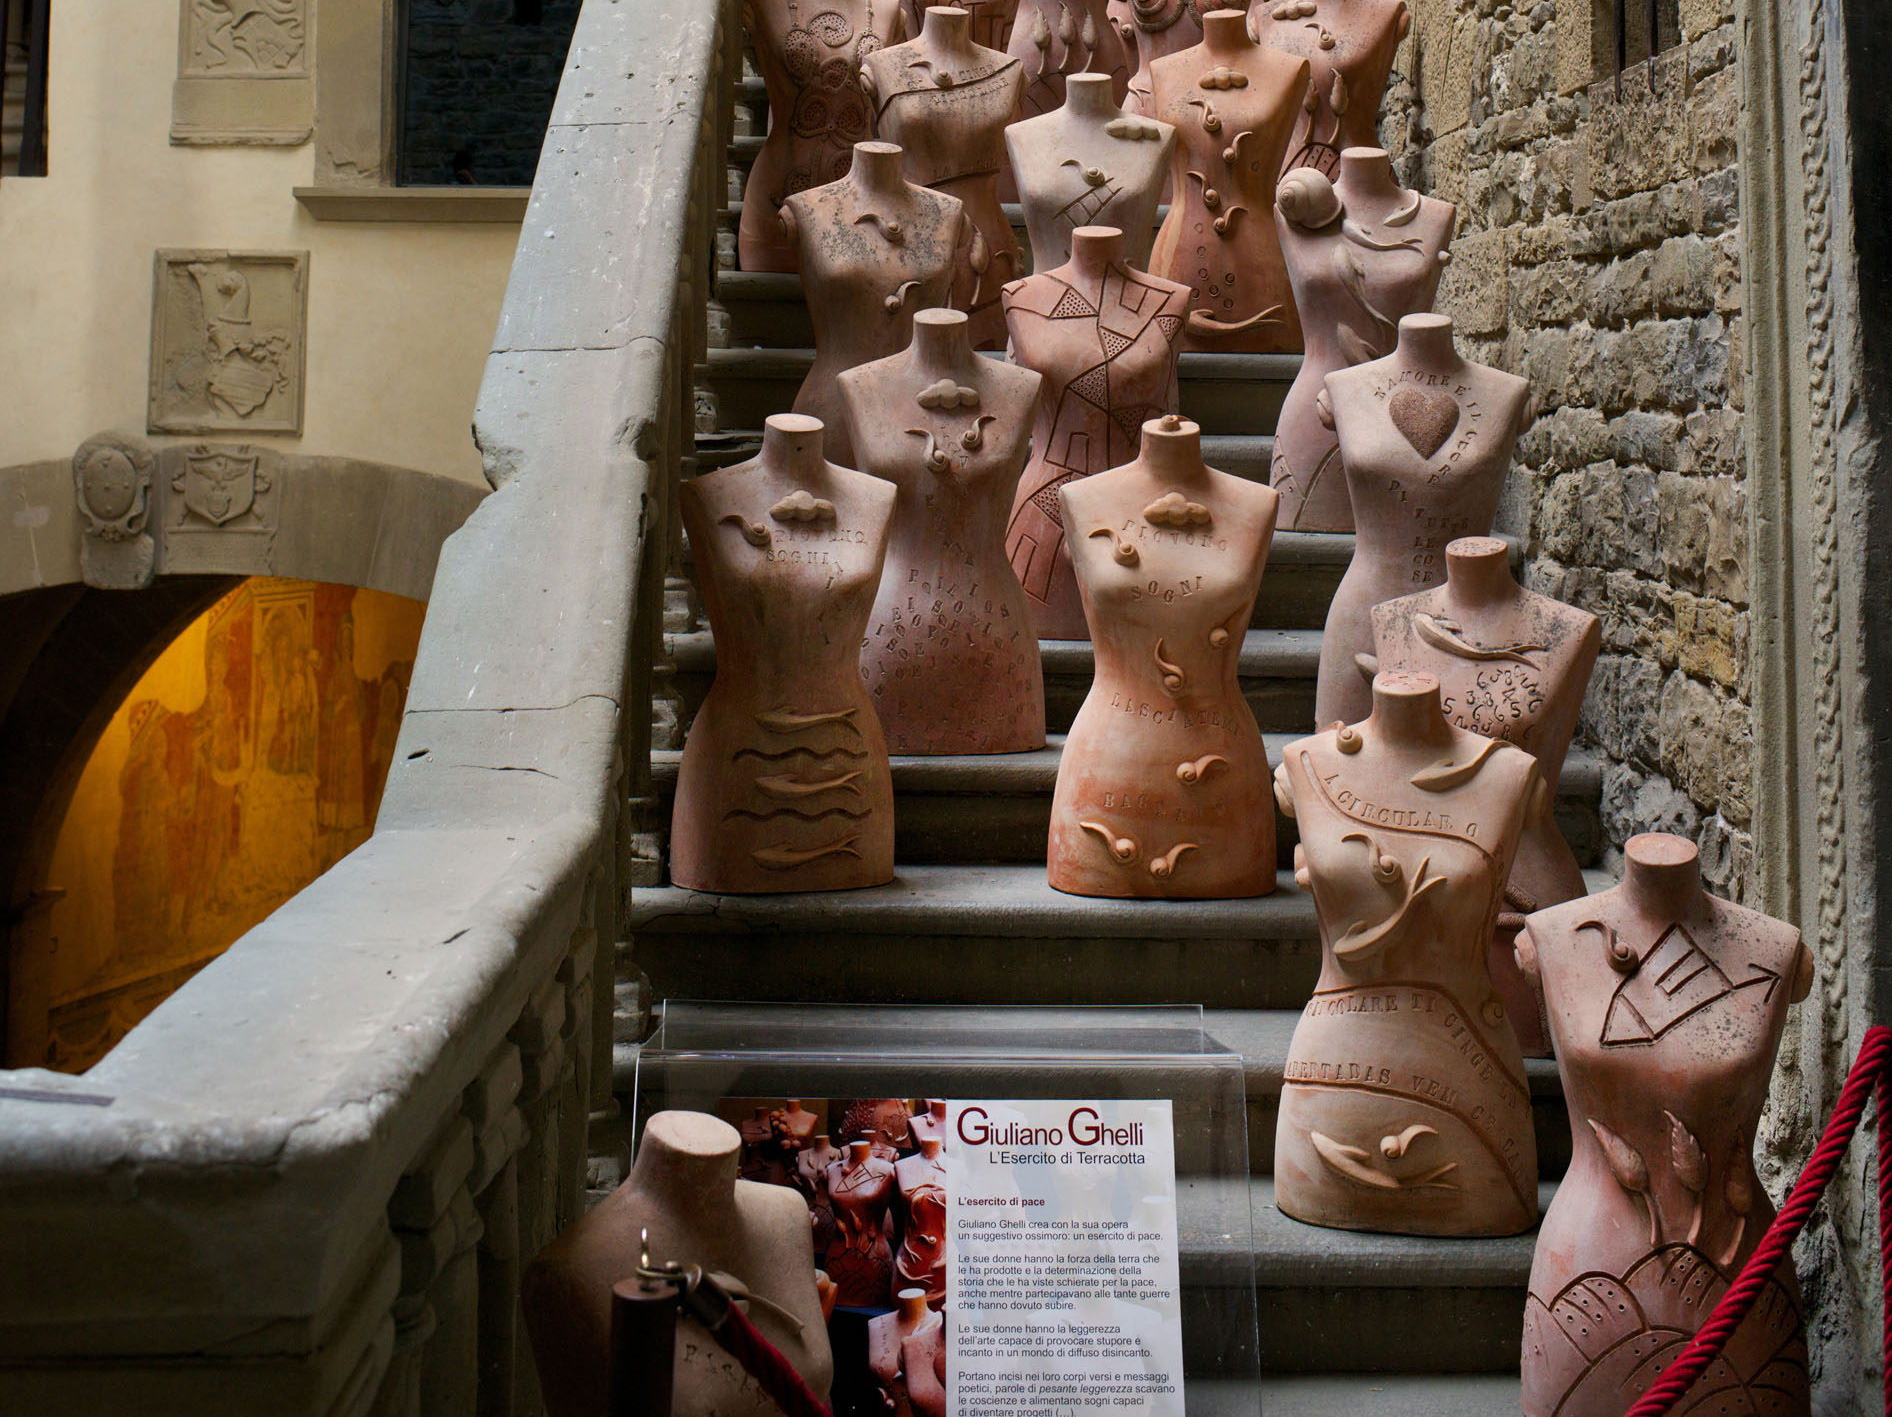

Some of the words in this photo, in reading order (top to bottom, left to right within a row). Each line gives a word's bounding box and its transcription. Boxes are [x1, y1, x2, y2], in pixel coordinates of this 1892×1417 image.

[1130, 575, 1204, 605] SOGNI
[957, 1107, 1063, 1146] Giuliano
[1068, 1107, 1144, 1146] Ghelli
[989, 1151, 1056, 1164] L'Esercito
[1060, 1151, 1072, 1164] di
[1076, 1151, 1145, 1164] Terracotta
[958, 1196, 1007, 1205] L'esercito
[1009, 1196, 1018, 1205] di
[1021, 1199, 1045, 1208] pace
[958, 1219, 996, 1228] Giuliano
[999, 1219, 1026, 1228] Ghelli
[1071, 1219, 1080, 1228] la
[1102, 1222, 1129, 1232] opera
[972, 1230, 1023, 1243] suggestivo
[1025, 1230, 1070, 1240] ossimoro:
[1088, 1230, 1124, 1240] esercito
[1126, 1230, 1135, 1240] di
[1138, 1233, 1163, 1243] pace.
[958, 1253, 970, 1263] Le
[992, 1253, 1022, 1263] donne
[1024, 1253, 1054, 1263] hanno
[1056, 1253, 1064, 1263] la
[1067, 1253, 1091, 1263] forza
[1093, 1253, 1116, 1263] della
[1118, 1254, 1140, 1263] terra
[1142, 1253, 1160, 1263] che
[958, 1264, 967, 1274] le
[969, 1264, 981, 1274] ha
[984, 1264, 1022, 1278] prodotte
[1034, 1264, 1042, 1274] la
[1044, 1264, 1117, 1274] determinazione
[1119, 1264, 1142, 1274] della
[958, 1276, 984, 1286] storia
[986, 1276, 1004, 1286] che
[1006, 1276, 1015, 1286] le
[1018, 1276, 1030, 1286] ha
[1032, 1276, 1054, 1286] viste
[1056, 1276, 1100, 1286] schierate
[1102, 1279, 1117, 1289] per
[1120, 1276, 1128, 1286] la
[1131, 1279, 1157, 1289] pace,
[958, 1288, 988, 1298] anche
[990, 1289, 1023, 1298] mentre
[1025, 1288, 1092, 1301] partecipavano
[1094, 1288, 1111, 1298] alle
[1113, 1289, 1137, 1298] tante
[1139, 1291, 1170, 1301] guerre
[958, 1299, 976, 1310] che
[978, 1299, 1008, 1310] hanno
[1010, 1299, 1042, 1310] dovuto
[1044, 1299, 1076, 1310] subire.
[958, 1323, 970, 1333] Le
[992, 1323, 1022, 1333] donne
[1025, 1323, 1055, 1333] hanno
[1058, 1323, 1066, 1333] la
[1068, 1323, 1121, 1336] leggerezza
[958, 1334, 996, 1345] dell'arte
[998, 1338, 1033, 1348] capace
[1035, 1334, 1044, 1345] di
[1046, 1338, 1094, 1348] provocare
[1096, 1336, 1132, 1348] stupore
[958, 1346, 993, 1357] incanto
[996, 1346, 1004, 1357] in
[1006, 1349, 1018, 1357] un
[1022, 1346, 1054, 1357] mondo
[1056, 1346, 1065, 1357] di
[1068, 1346, 1100, 1357] diffuso
[1102, 1346, 1152, 1357] disincanto.
[958, 1370, 996, 1381] Portano
[998, 1370, 1022, 1381] incisi
[1025, 1370, 1040, 1381] nei
[1042, 1370, 1060, 1381] loro
[1063, 1370, 1086, 1384] corpi
[1089, 1370, 1112, 1381] versi
[1124, 1370, 1169, 1384] messaggi
[958, 1383, 992, 1396] poetici,
[995, 1383, 1025, 1396] parole
[1028, 1383, 1036, 1393] di
[1038, 1384, 1078, 1396] pesante
[1080, 1383, 1133, 1396] leggerezza
[958, 1394, 967, 1405] le
[969, 1394, 1018, 1405] coscienze
[1020, 1397, 1026, 1405] e
[1029, 1394, 1082, 1405] alimentano
[1084, 1394, 1110, 1408] sogni
[1112, 1394, 1144, 1408] capaci
[958, 1406, 967, 1417] di
[969, 1406, 1014, 1417] diventare
